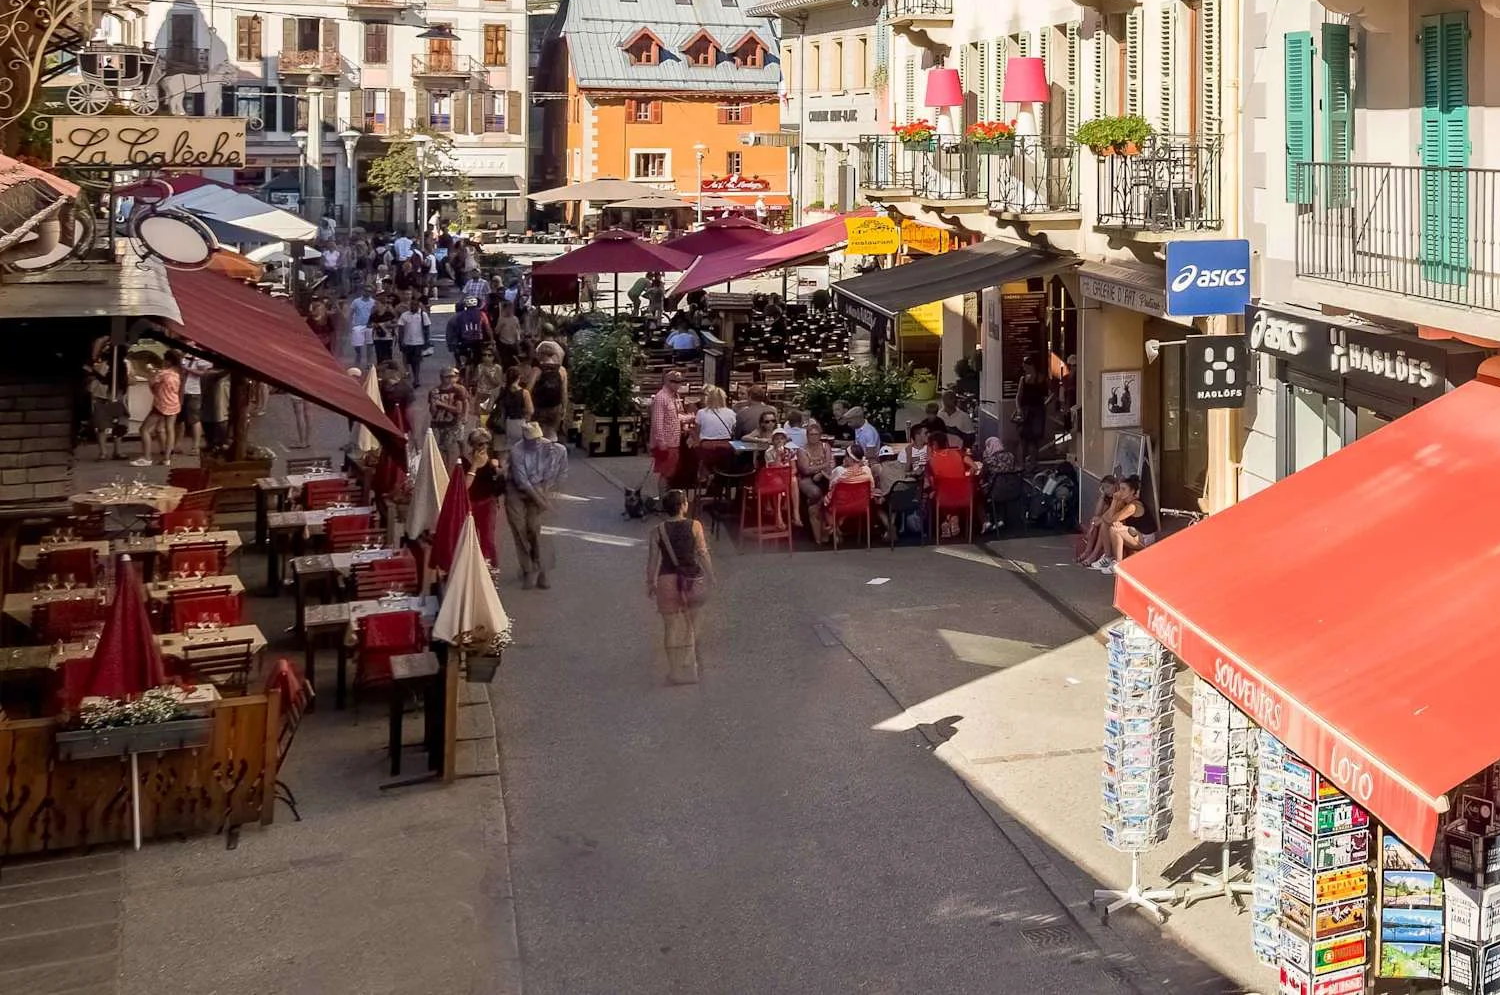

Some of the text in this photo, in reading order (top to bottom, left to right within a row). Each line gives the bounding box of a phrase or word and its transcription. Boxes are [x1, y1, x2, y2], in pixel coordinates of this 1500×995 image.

[1196, 267, 1247, 288] asics
[1350, 342, 1433, 388] HAGLÖFS
[1146, 605, 1179, 649] TABAC
[1214, 657, 1282, 732] SOUVENIRS
[1329, 745, 1374, 801] LOTO
